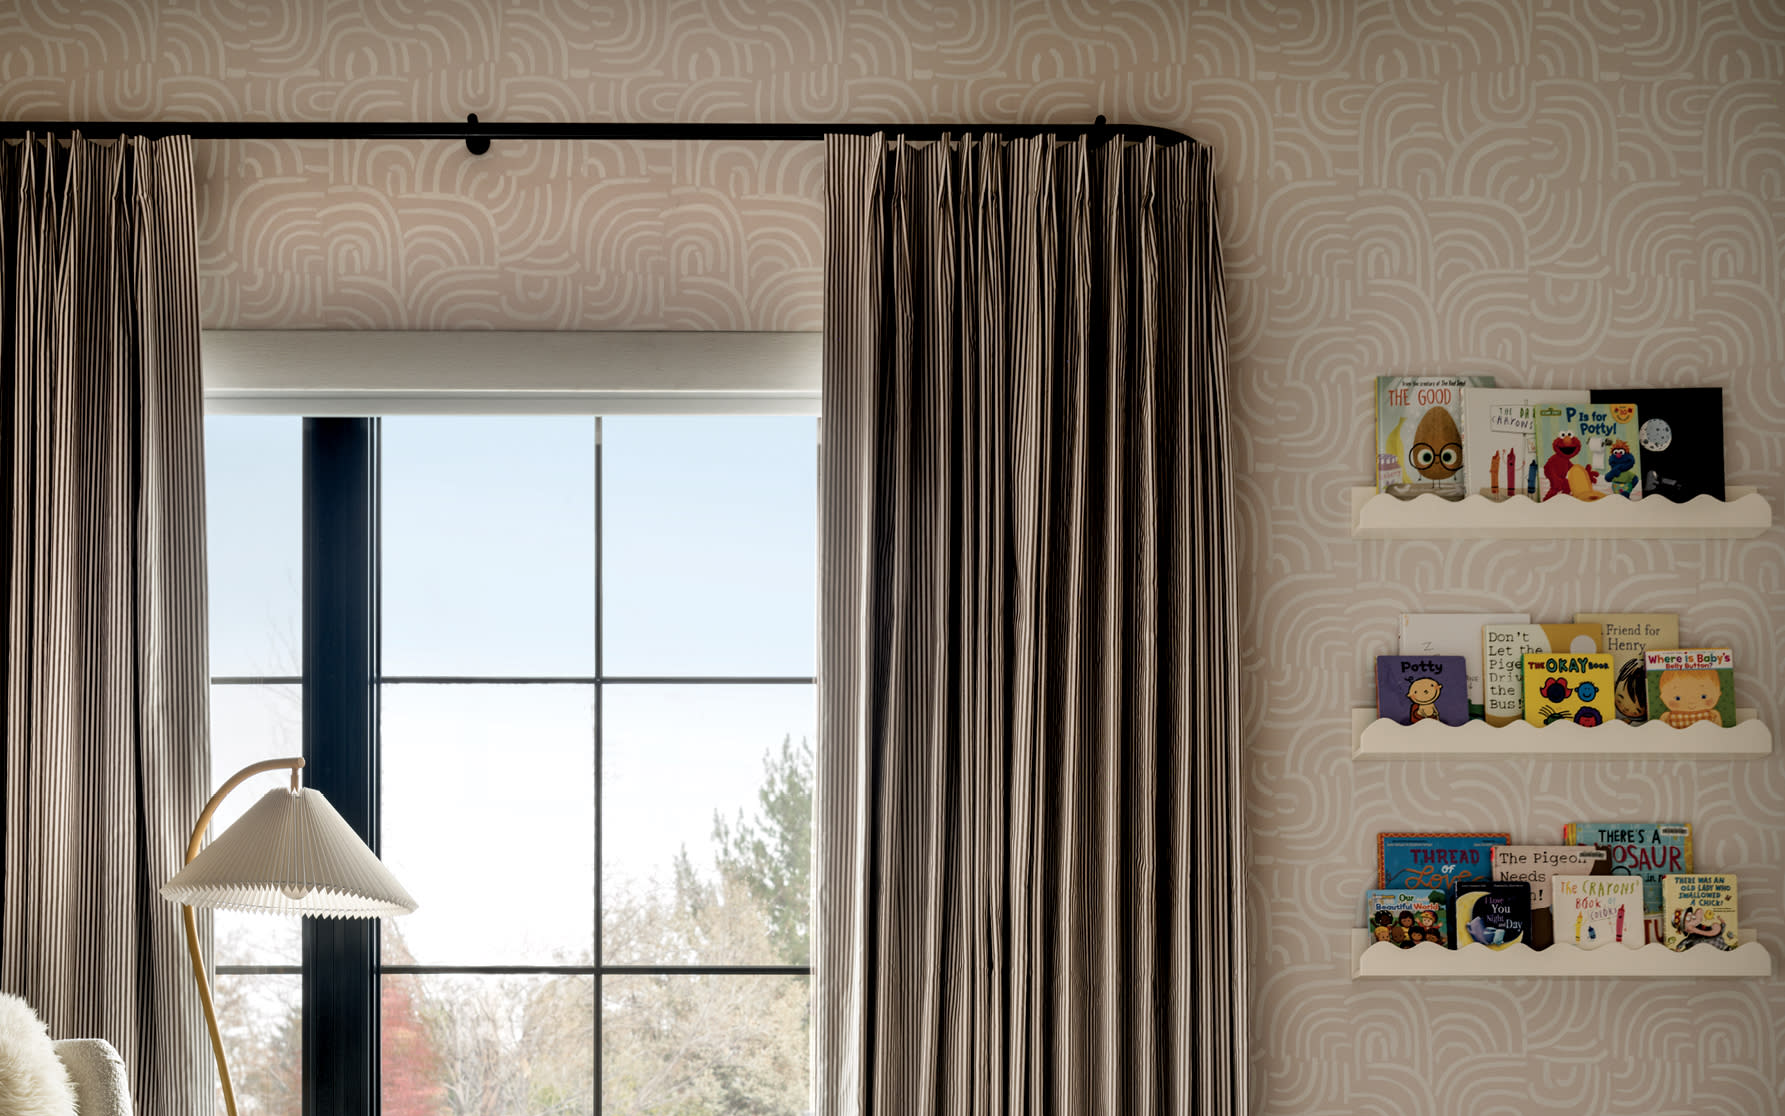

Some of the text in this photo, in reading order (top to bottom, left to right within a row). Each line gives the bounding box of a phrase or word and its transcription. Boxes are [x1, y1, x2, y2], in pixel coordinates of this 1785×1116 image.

[1388, 388, 1452, 407] THE GOOD
[1499, 407, 1512, 416] THE
[1566, 407, 1577, 422] P
[1579, 412, 1589, 422] Is
[1592, 411, 1607, 422] for
[1580, 423, 1617, 436] Potty!
[1606, 623, 1661, 636] Friend for
[1488, 632, 1529, 643] Don't
[1488, 645, 1543, 656] Let the
[1607, 637, 1646, 655] Henry
[1648, 651, 1731, 665] Where is Baby's
[1400, 660, 1443, 675] Potty
[1488, 658, 1522, 672] Pige
[1546, 657, 1588, 673] OKAY
[1489, 672, 1522, 682] Driv
[1490, 685, 1515, 696] the
[1489, 699, 1522, 710] Bus!
[1598, 829, 1645, 844] THERE'S
[1652, 830, 1661, 844] A
[1409, 848, 1480, 865] THREAD
[1499, 852, 1527, 864] The
[1404, 865, 1472, 890] Love
[1500, 871, 1546, 882] Needs
[1560, 880, 1578, 895] The
[1399, 893, 1415, 903] Our
[1375, 903, 1412, 911] Beautiful
[1490, 904, 1512, 914] You
[1486, 914, 1505, 924] Night
[1505, 919, 1523, 932] Day
